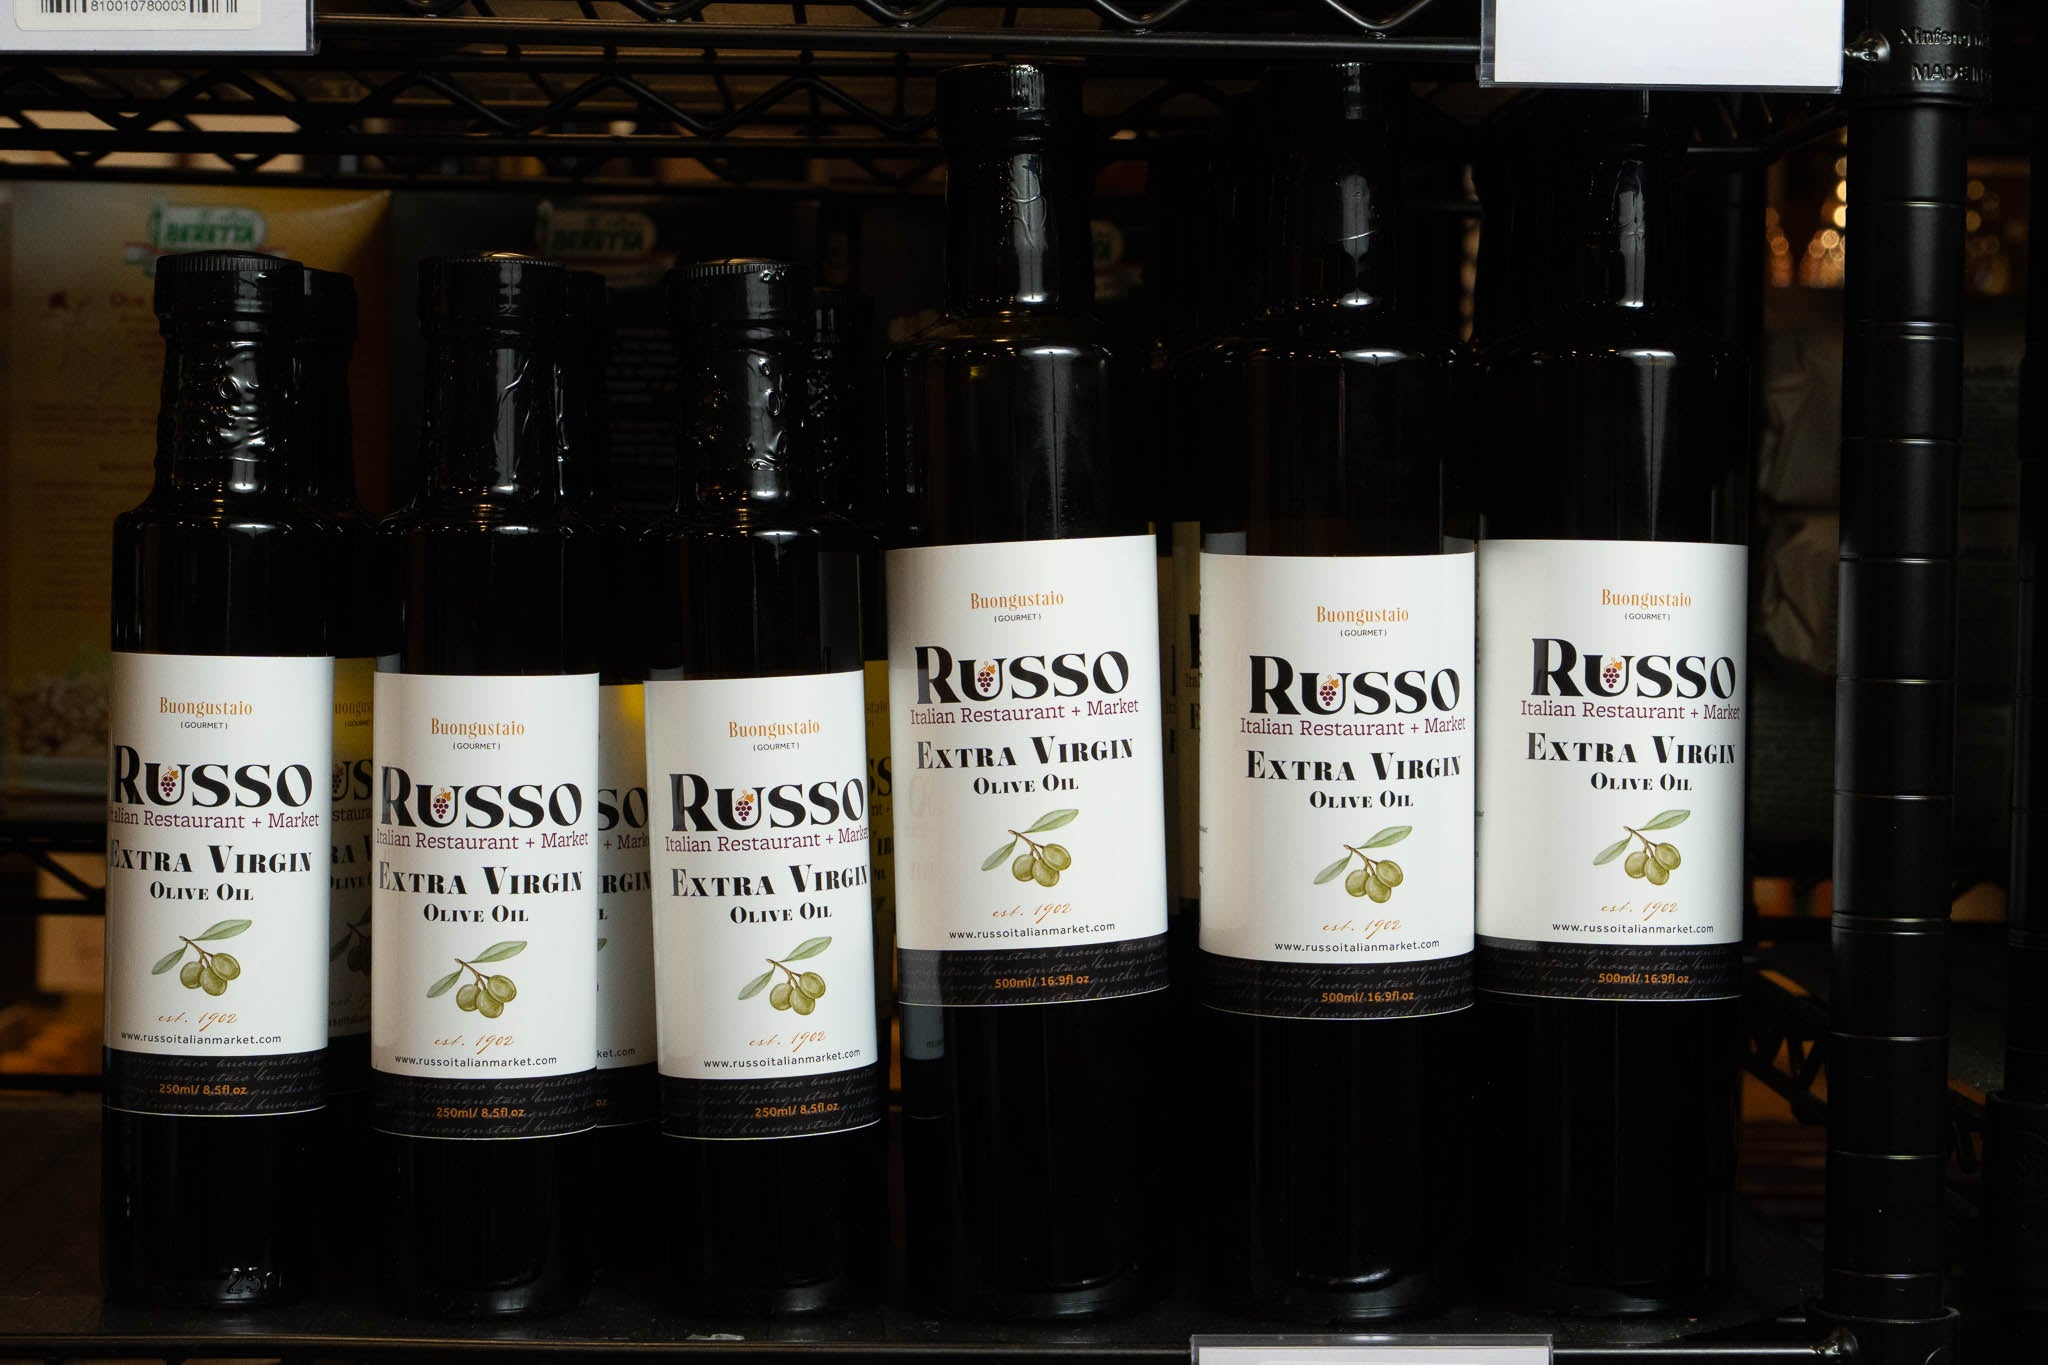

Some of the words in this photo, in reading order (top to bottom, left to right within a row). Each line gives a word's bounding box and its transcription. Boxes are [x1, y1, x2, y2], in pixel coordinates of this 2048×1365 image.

[90, 0, 187, 12] 810010780003
[971, 590, 1065, 611] Buongustaio
[1602, 588, 1692, 609] Buongustaio
[1316, 605, 1409, 626] Buongustaio
[914, 646, 1129, 704] RUSSO
[1530, 638, 1736, 699] RUSSO
[1249, 655, 1460, 715] RUSSO
[159, 697, 253, 717] Buongustaio
[910, 709, 956, 725] Italian
[960, 705, 1065, 724] Restaurant
[1087, 698, 1139, 717] Market
[1521, 700, 1576, 717] Italian
[1582, 702, 1686, 719] Restaurant
[431, 717, 525, 739] Buongustaio
[729, 719, 820, 739] Buongustaio
[1240, 717, 1293, 735] Italian
[1299, 720, 1404, 736] Restaurant
[1424, 716, 1466, 734] Market
[917, 741, 1017, 770] EXTRA
[1029, 736, 1135, 765] VIRGIN
[1527, 732, 1638, 763] EXTRA
[1652, 735, 1736, 764] VIRGIN
[1245, 749, 1356, 781] EXTRA
[1369, 752, 1462, 781] VIRGIN
[973, 777, 1035, 795] OLIVE
[1042, 774, 1079, 792] OIL
[1591, 771, 1653, 790] OLIVE
[1660, 773, 1692, 791] OIL
[380, 765, 583, 829] RUSSO
[669, 773, 865, 832] RUSSO
[1309, 790, 1372, 809] OLIVE
[1379, 790, 1414, 808] OIL
[144, 809, 245, 828] Restaurant
[268, 812, 320, 829] Market
[376, 829, 410, 848] Italian
[416, 832, 519, 850] Restaurant
[541, 831, 588, 849] Market
[665, 836, 712, 852] Italian
[717, 832, 821, 851] Restaurant
[207, 845, 312, 873] VIRGIN
[379, 861, 468, 894] EXTRA
[481, 866, 583, 895] VIRGIN
[671, 868, 776, 897] EXTRA
[789, 863, 868, 894] VIRGIN
[150, 881, 209, 901] OLIVE
[217, 883, 254, 901] OIL
[423, 903, 484, 922] OLIVE
[491, 905, 529, 922] OIL
[730, 906, 793, 924] OLIVE
[800, 902, 832, 920] OIL
[992, 904, 1024, 918] est.
[1034, 903, 1072, 924] 1902
[1601, 901, 1632, 913] est.
[1642, 901, 1680, 921] 1902
[949, 922, 1116, 940] www.russoitalianmarket.com
[1322, 920, 1354, 932] est.
[1364, 919, 1401, 940] 1902
[1552, 922, 1715, 934] www.russoitalianmarket.com
[1274, 939, 1440, 953] www.russoitalianmarket.com
[157, 1011, 188, 1024] est.
[198, 1012, 238, 1032] 1902
[121, 1031, 282, 1045] www.russoitalianmarket.com
[434, 1035, 465, 1047] est.
[474, 1034, 514, 1055] 1902
[749, 1033, 781, 1047] est.
[791, 1030, 826, 1053] 1902
[395, 1055, 557, 1068] www.russoitalianmarket.com
[704, 1049, 861, 1068] www.russoitalianmarket.com
